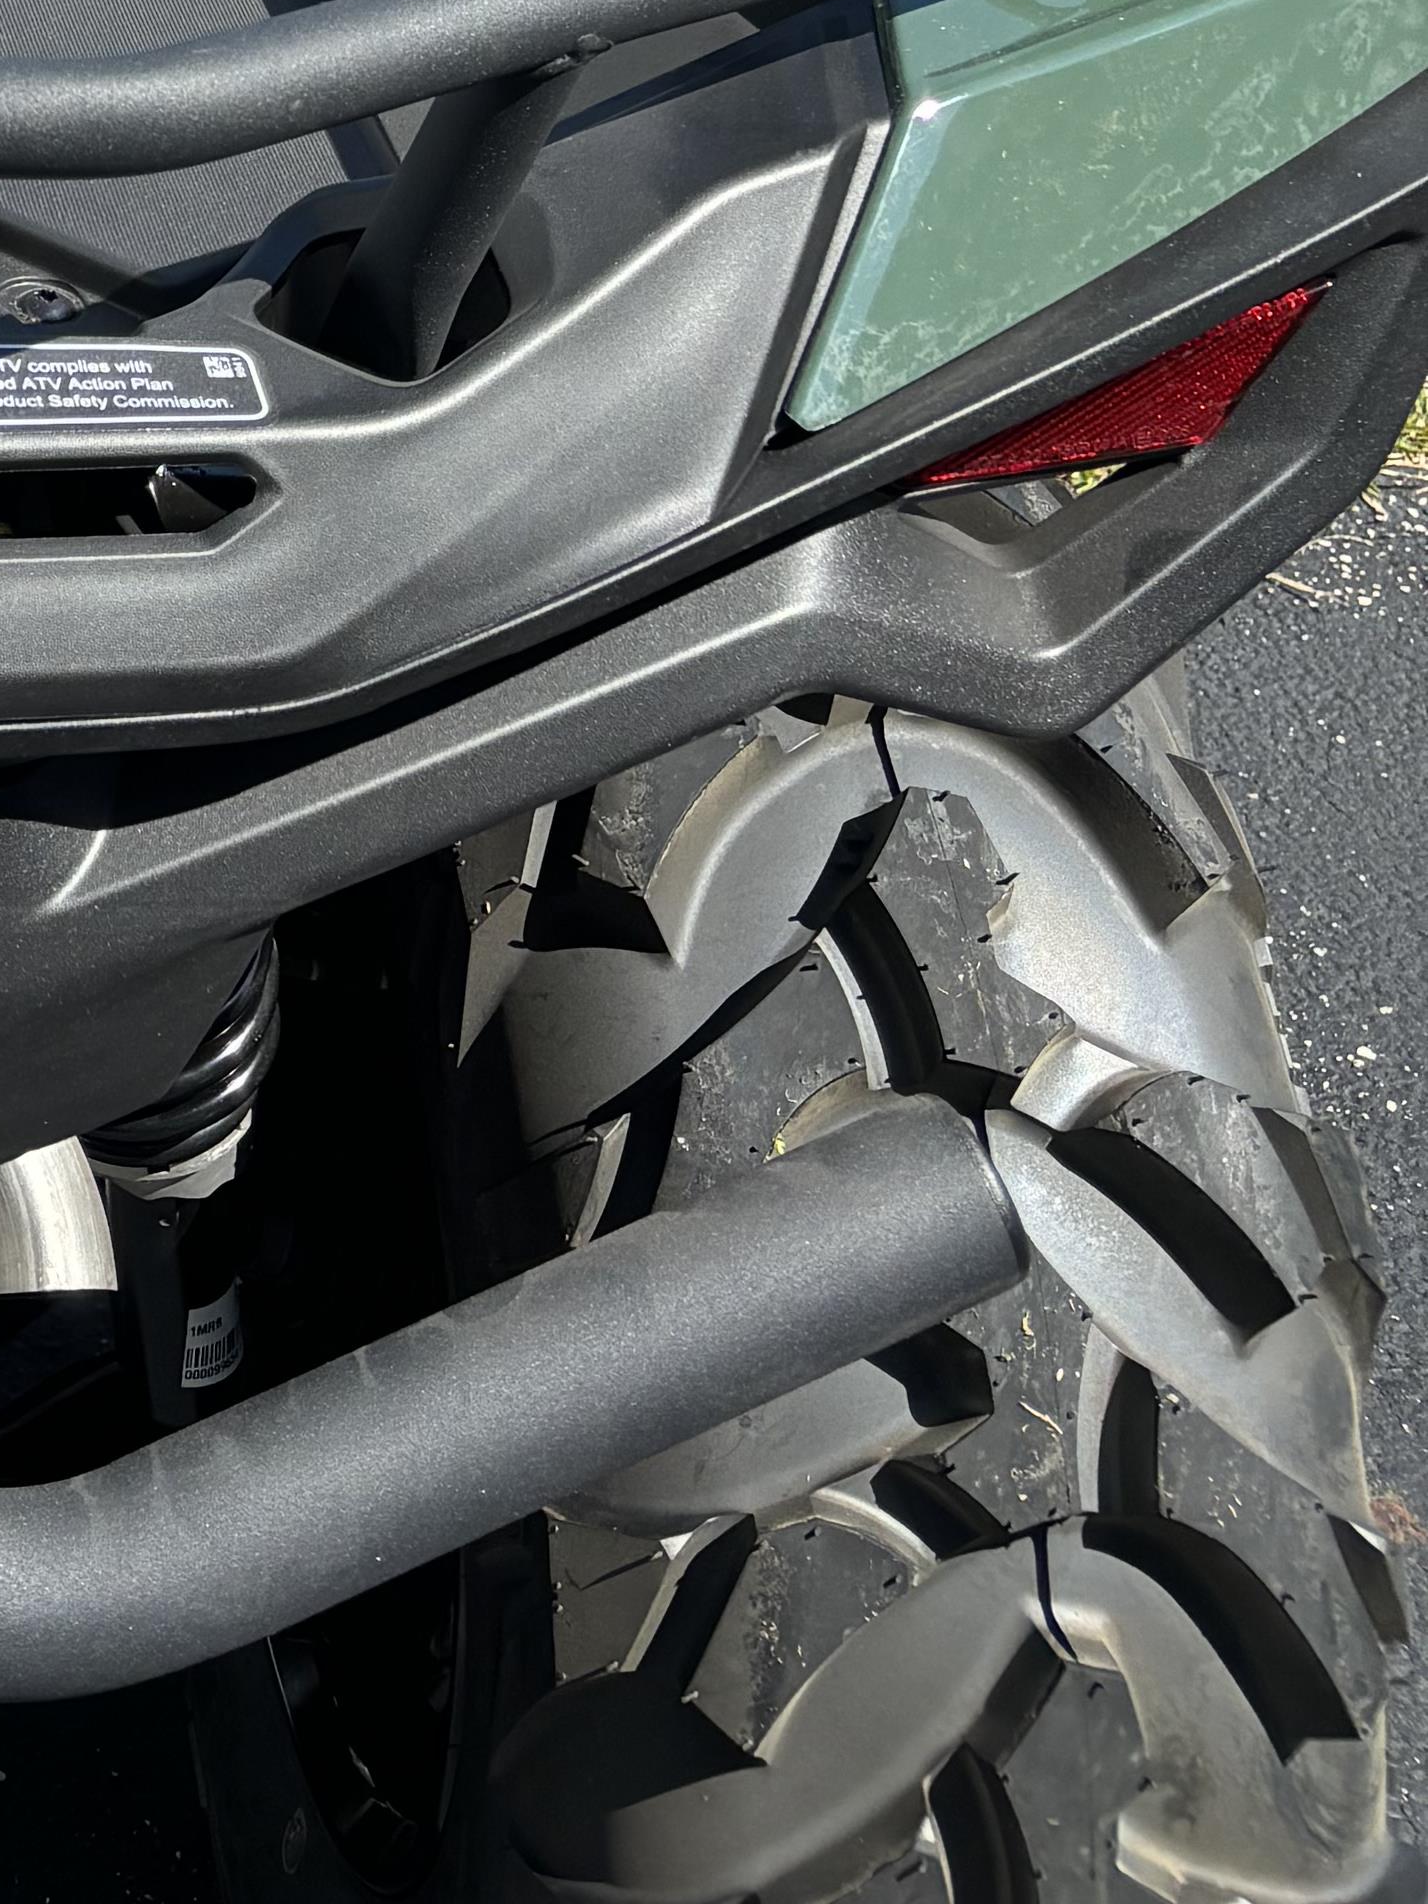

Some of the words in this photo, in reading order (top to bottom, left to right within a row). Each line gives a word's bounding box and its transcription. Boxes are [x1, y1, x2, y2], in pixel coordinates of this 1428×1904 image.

[27, 359, 112, 374] complies
[113, 360, 153, 373] with
[22, 377, 63, 390] ATV
[68, 377, 127, 391] Action
[131, 378, 174, 391] Plan
[47, 394, 108, 411] Safety
[113, 394, 234, 409] Commission.
